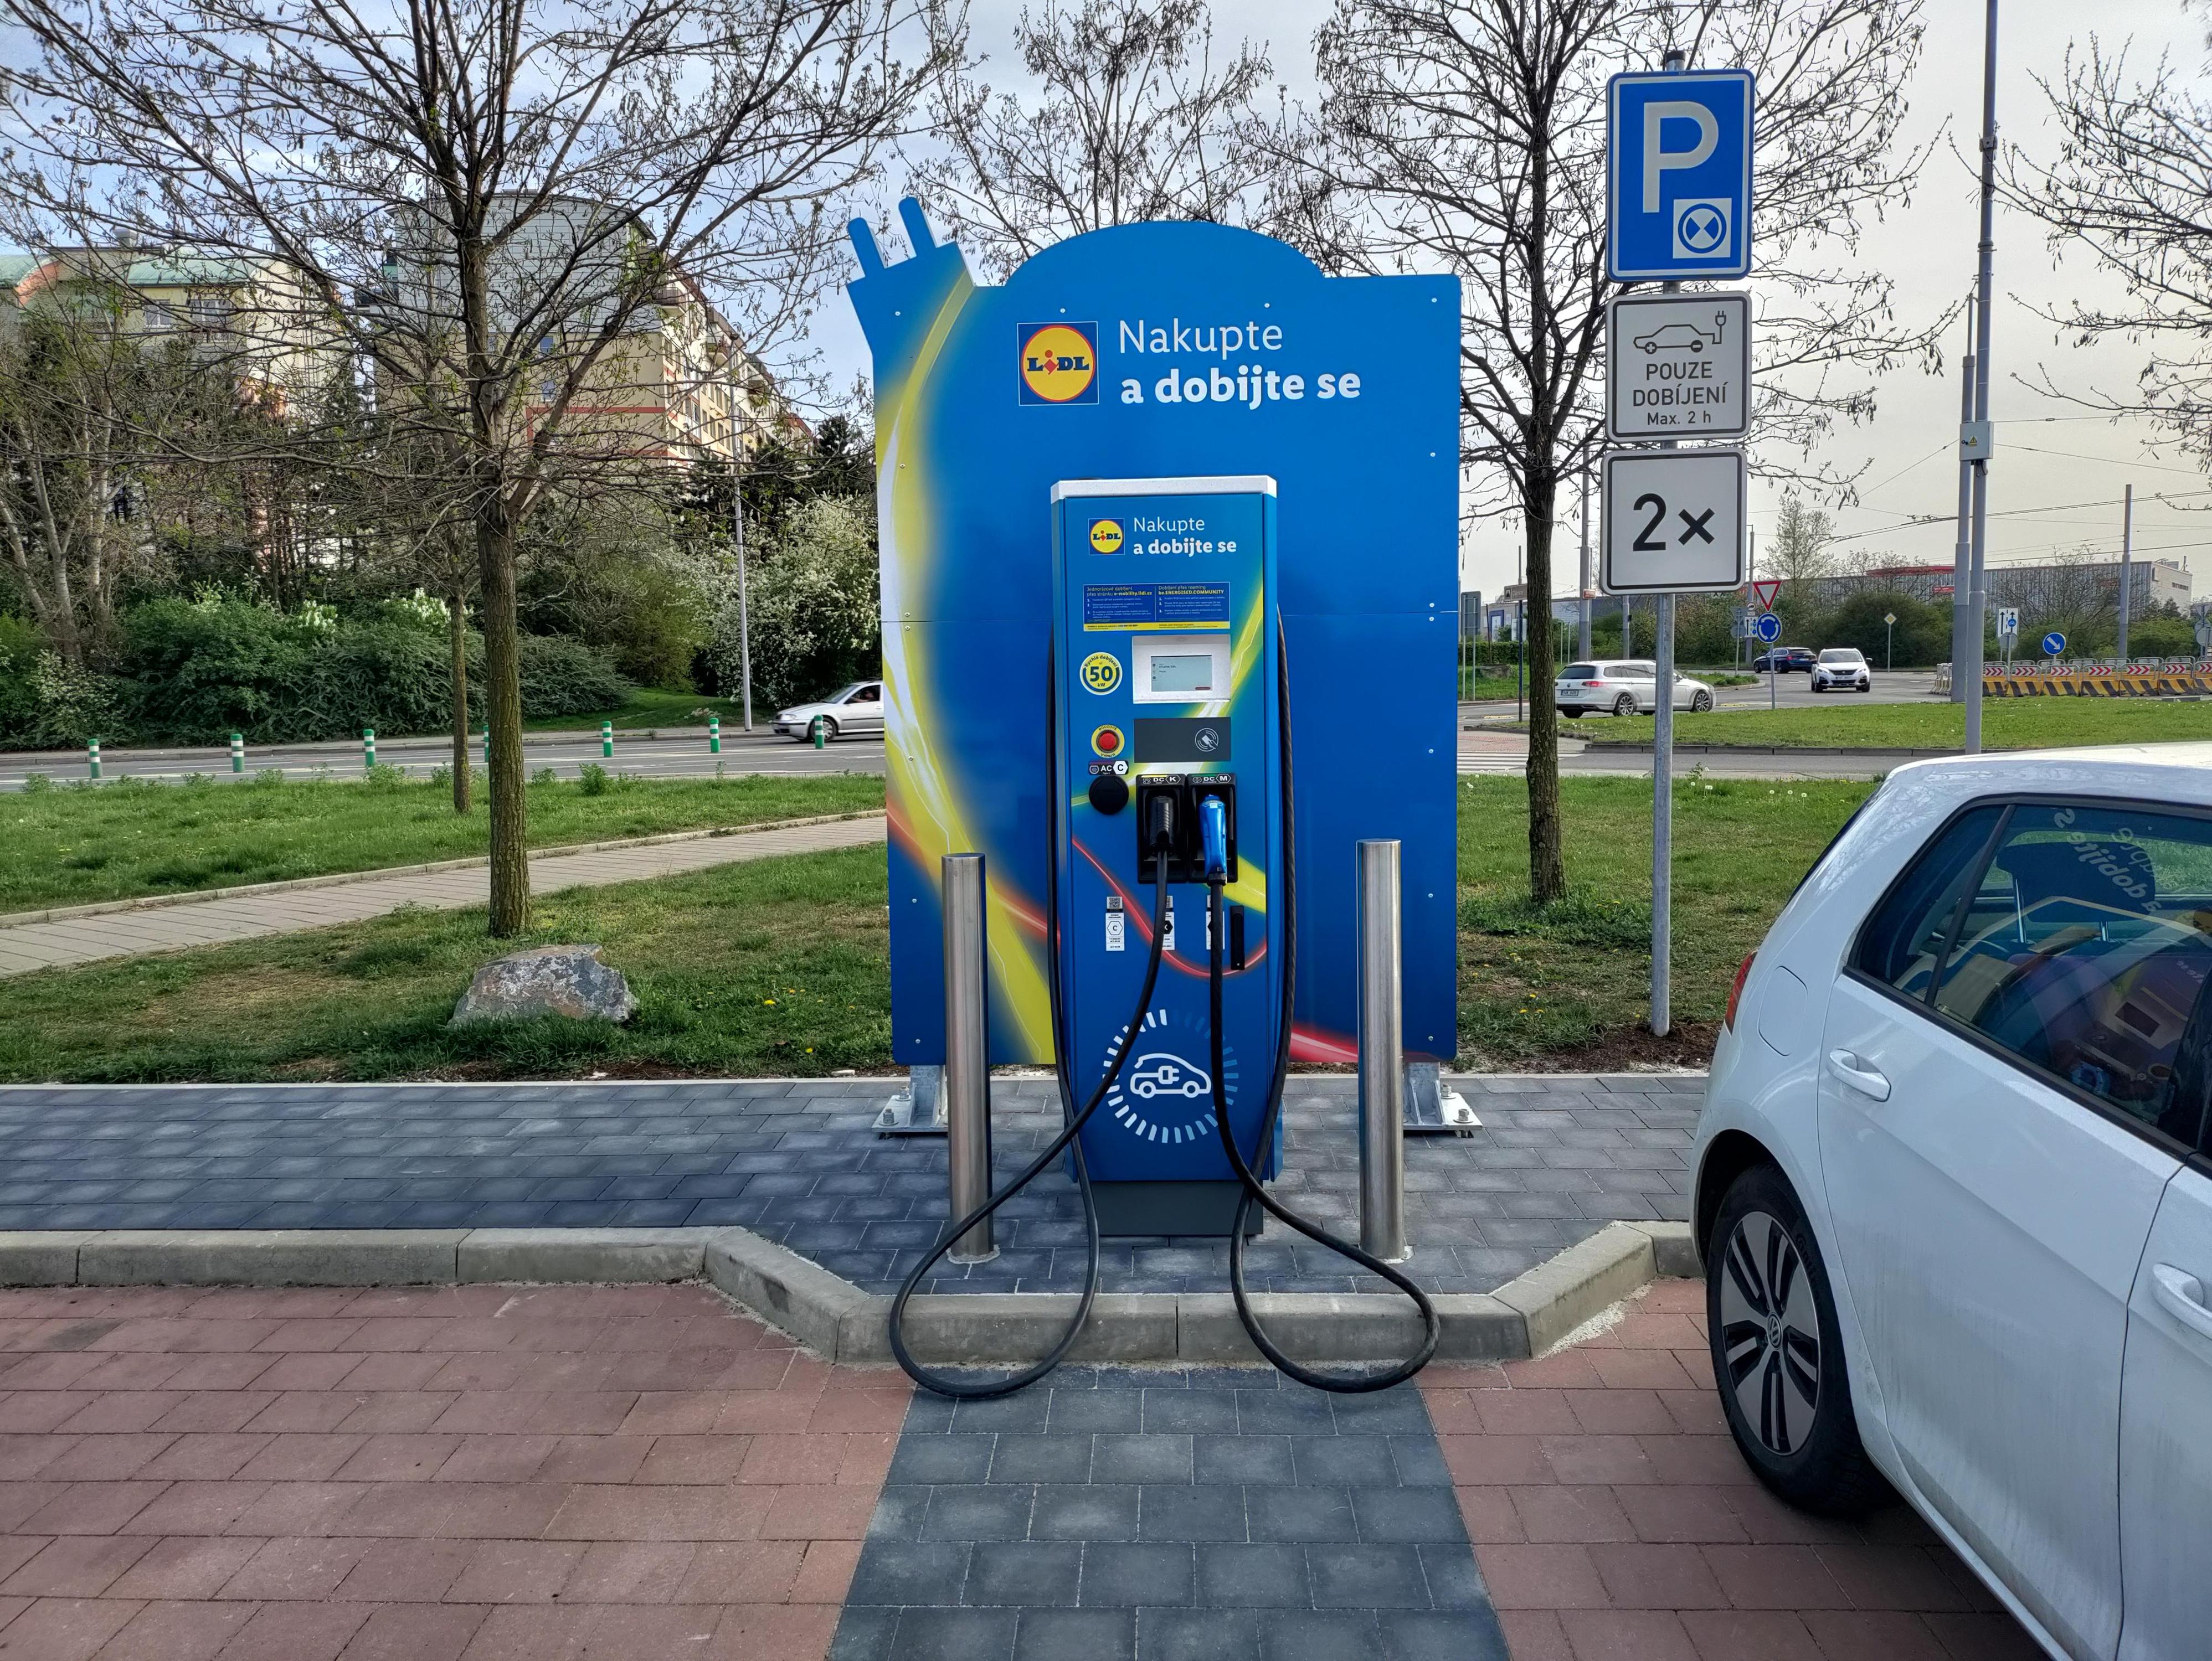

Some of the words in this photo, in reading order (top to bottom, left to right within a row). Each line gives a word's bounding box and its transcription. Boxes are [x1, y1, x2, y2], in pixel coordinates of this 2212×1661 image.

[1643, 101, 1719, 213] P
[1120, 318, 1284, 360] Nakupte
[1646, 361, 1713, 380] POUZE
[1121, 379, 1144, 404] a
[1154, 365, 1304, 410] dobijte
[1316, 372, 1361, 399] se
[1633, 381, 1728, 406] DOBÍJENÍ
[1647, 413, 1680, 425] Max.
[1688, 411, 1696, 424] 2
[1703, 410, 1711, 424] h
[1134, 517, 1206, 534] Nakupte
[1133, 541, 1144, 555] a
[1148, 538, 1213, 558] dobijte
[1217, 540, 1237, 553] se
[1084, 656, 1099, 668] Rychlé
[1090, 666, 1113, 682] 50
